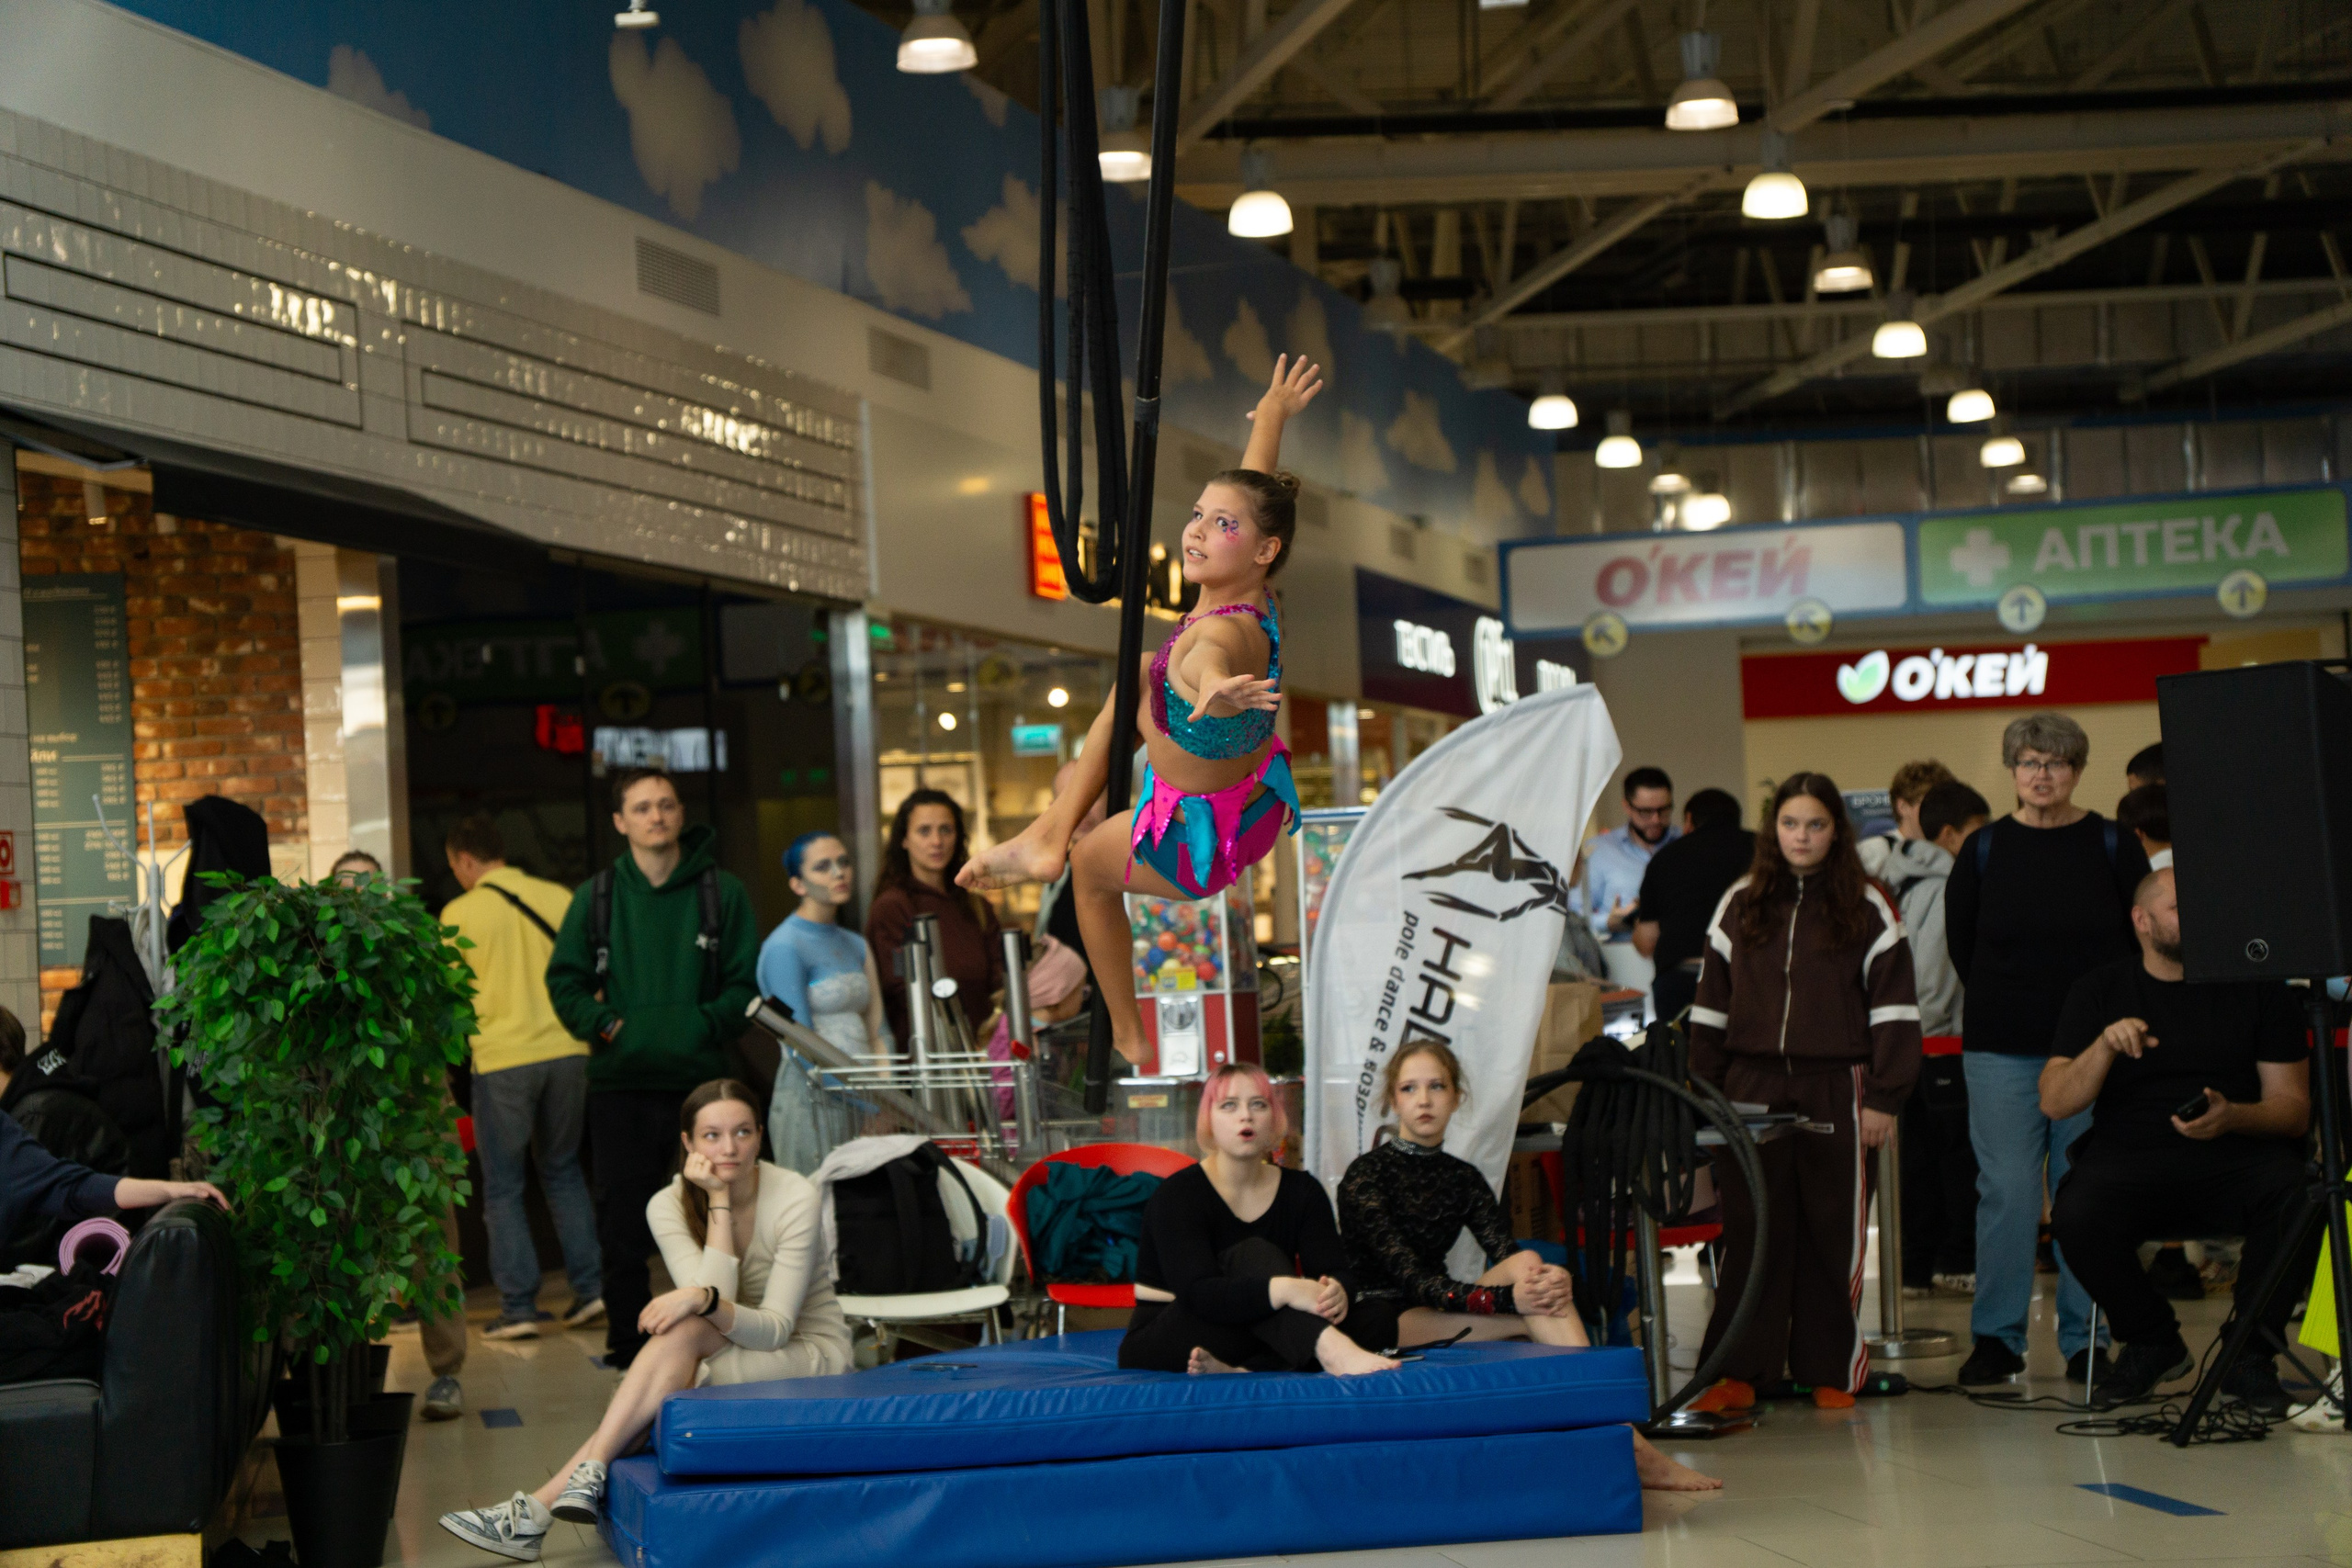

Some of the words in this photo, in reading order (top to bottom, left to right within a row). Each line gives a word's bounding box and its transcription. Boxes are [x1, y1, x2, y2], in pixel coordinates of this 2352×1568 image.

[2032, 512, 2290, 573] АПТЕКА
[1395, 910, 1419, 961] pole
[1374, 964, 1406, 1032] dance
[1369, 1036, 1386, 1052] &
